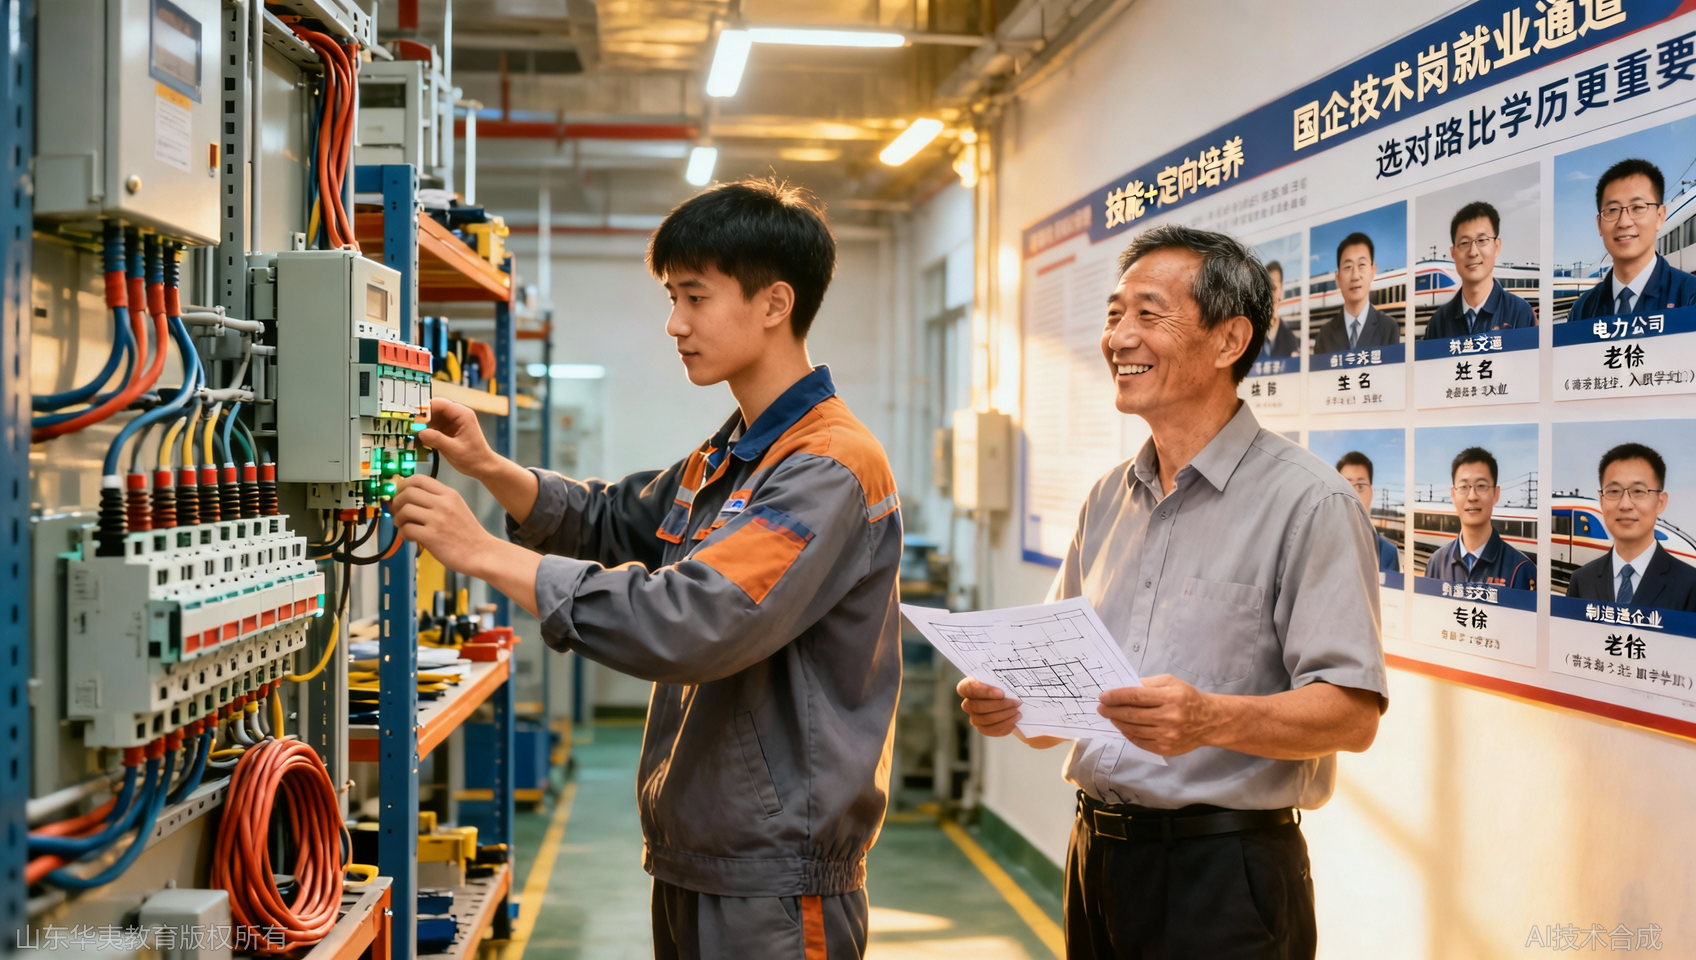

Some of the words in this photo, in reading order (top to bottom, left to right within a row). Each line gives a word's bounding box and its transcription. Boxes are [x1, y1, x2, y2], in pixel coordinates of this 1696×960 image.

[1293, 0, 1626, 151] 国企技术岗就业通道
[1376, 31, 1696, 180] 选对路比学历更重要
[1105, 136, 1244, 230] 技能+定向培养
[1593, 314, 1665, 339] 电力公司
[1603, 343, 1646, 369] 老徐
[1604, 633, 1647, 660] 老徐
